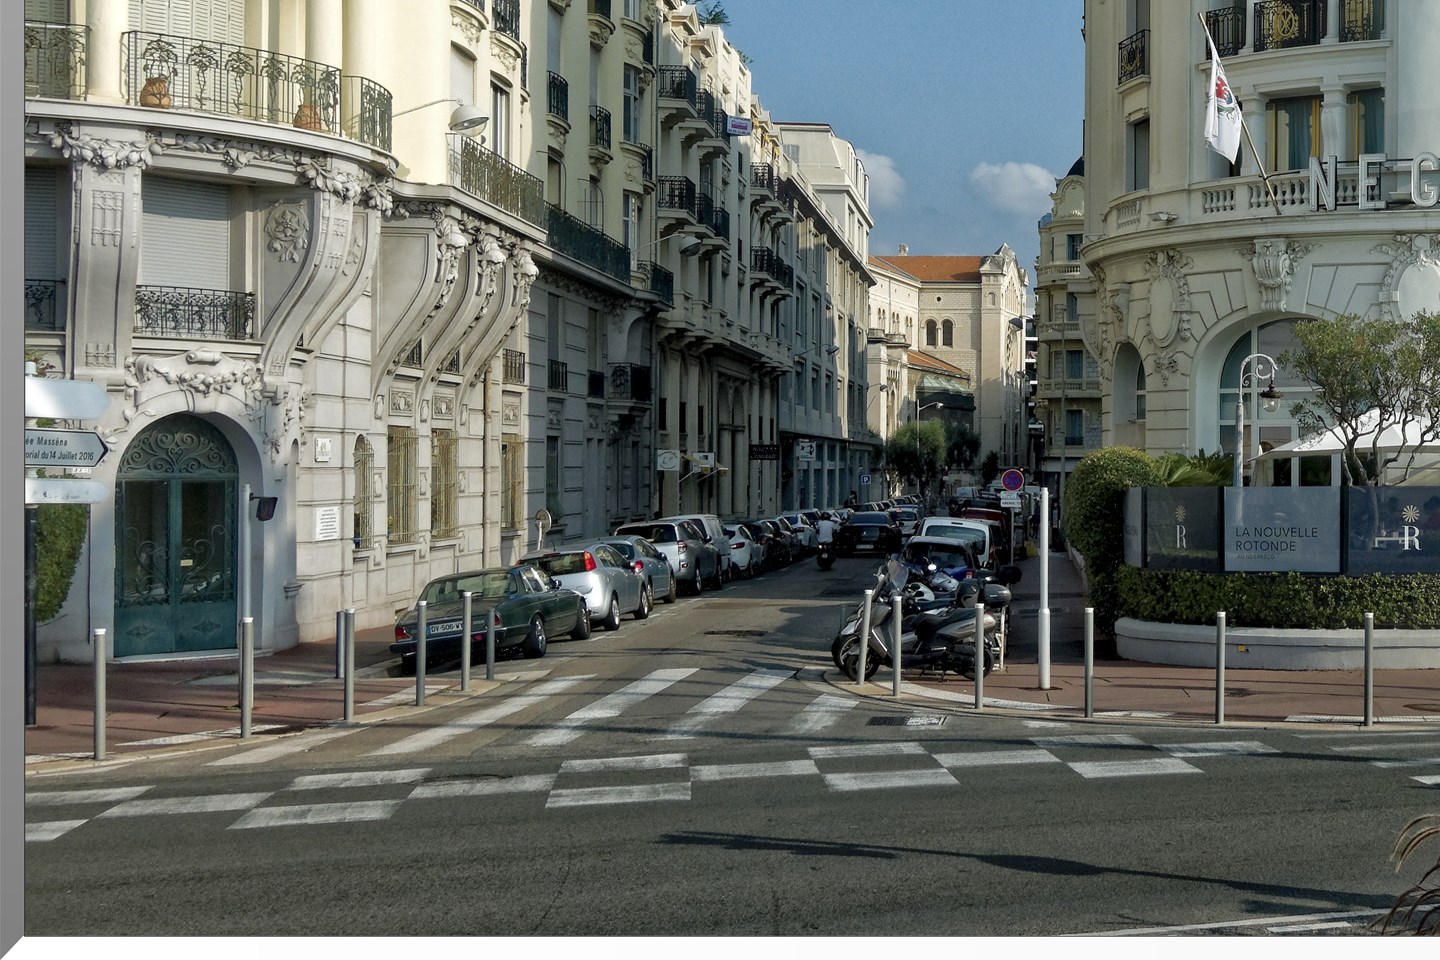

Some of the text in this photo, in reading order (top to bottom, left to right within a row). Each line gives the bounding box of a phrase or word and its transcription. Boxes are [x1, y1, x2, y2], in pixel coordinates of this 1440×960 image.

[37, 437, 68, 447] Masséna
[58, 451, 78, 460] Juillet
[79, 452, 94, 461] 2016
[1235, 527, 1318, 538] LA NOUVELLE
[1235, 540, 1296, 552] ROTONDE
